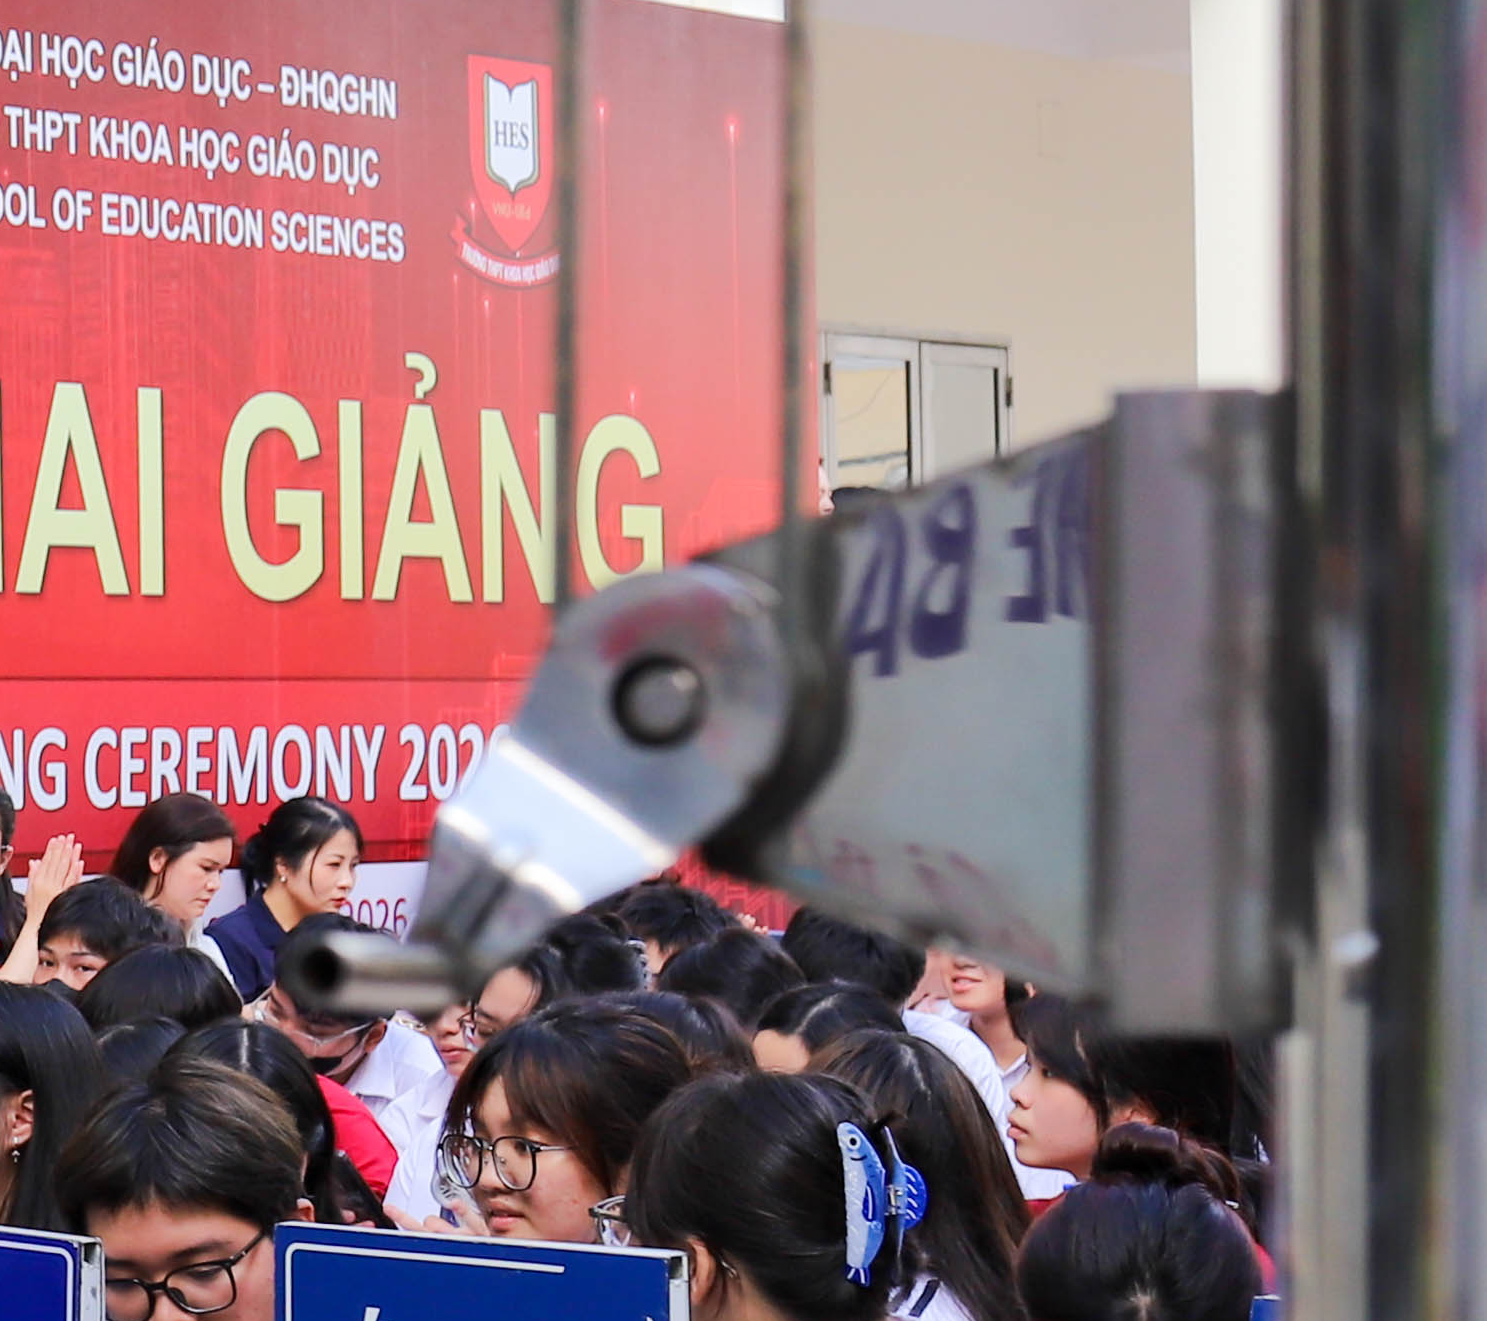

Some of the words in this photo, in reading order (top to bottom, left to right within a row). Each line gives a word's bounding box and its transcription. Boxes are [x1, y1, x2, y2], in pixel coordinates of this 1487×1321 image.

[40, 33, 105, 89] HỌC
[112, 37, 185, 93] GIÁO
[192, 53, 251, 108] DỤC
[280, 65, 397, 120] ĐHQGHN
[4, 104, 81, 155] THPT
[90, 116, 174, 166] KHOA
[179, 126, 240, 180] HỌC
[247, 128, 316, 182] GIÁO
[322, 143, 380, 196] DỤC
[494, 120, 529, 150] HES
[52, 187, 93, 232] OF
[101, 192, 264, 249] EDUCATION
[270, 209, 405, 263] SCIENCES
[218, 352, 665, 606] GIẢNG
[83, 724, 386, 810] CEREMONY
[398, 723, 512, 802] 202
